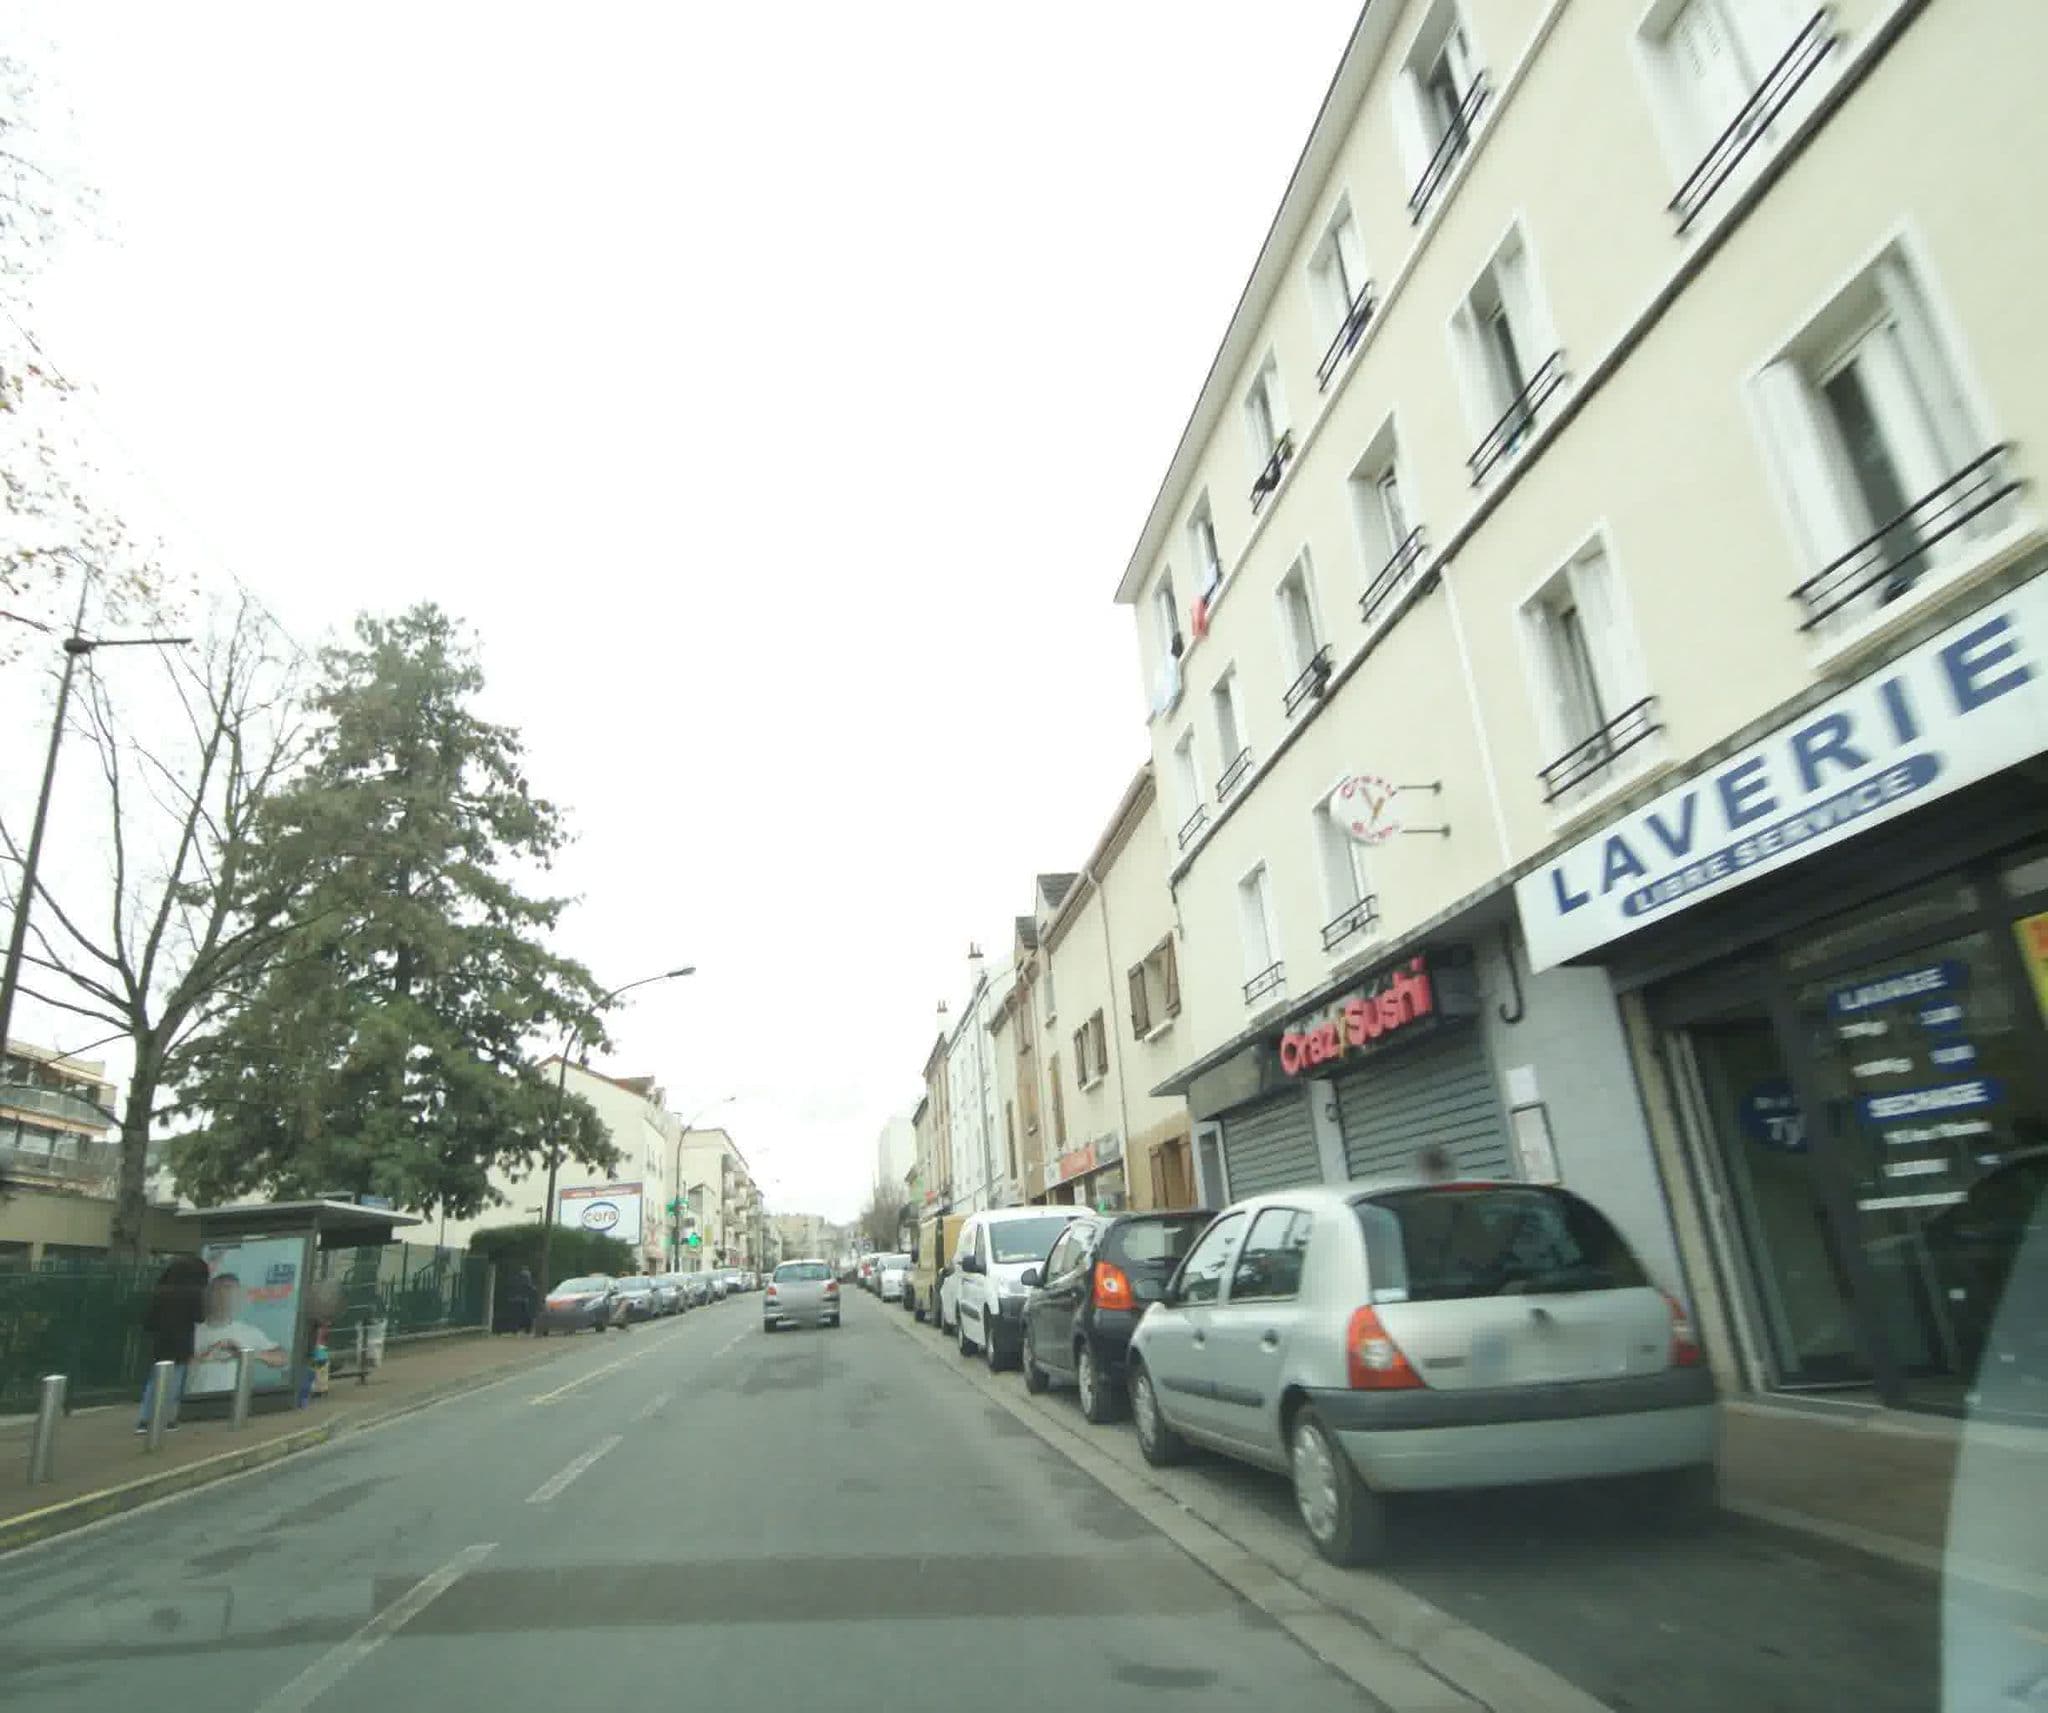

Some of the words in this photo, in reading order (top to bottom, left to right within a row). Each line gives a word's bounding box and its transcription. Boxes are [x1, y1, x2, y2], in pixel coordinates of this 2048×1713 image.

[1551, 612, 2034, 916] LAVERIE
[1634, 853, 1733, 913] LIBRE
[1732, 763, 1918, 867] SERVICE
